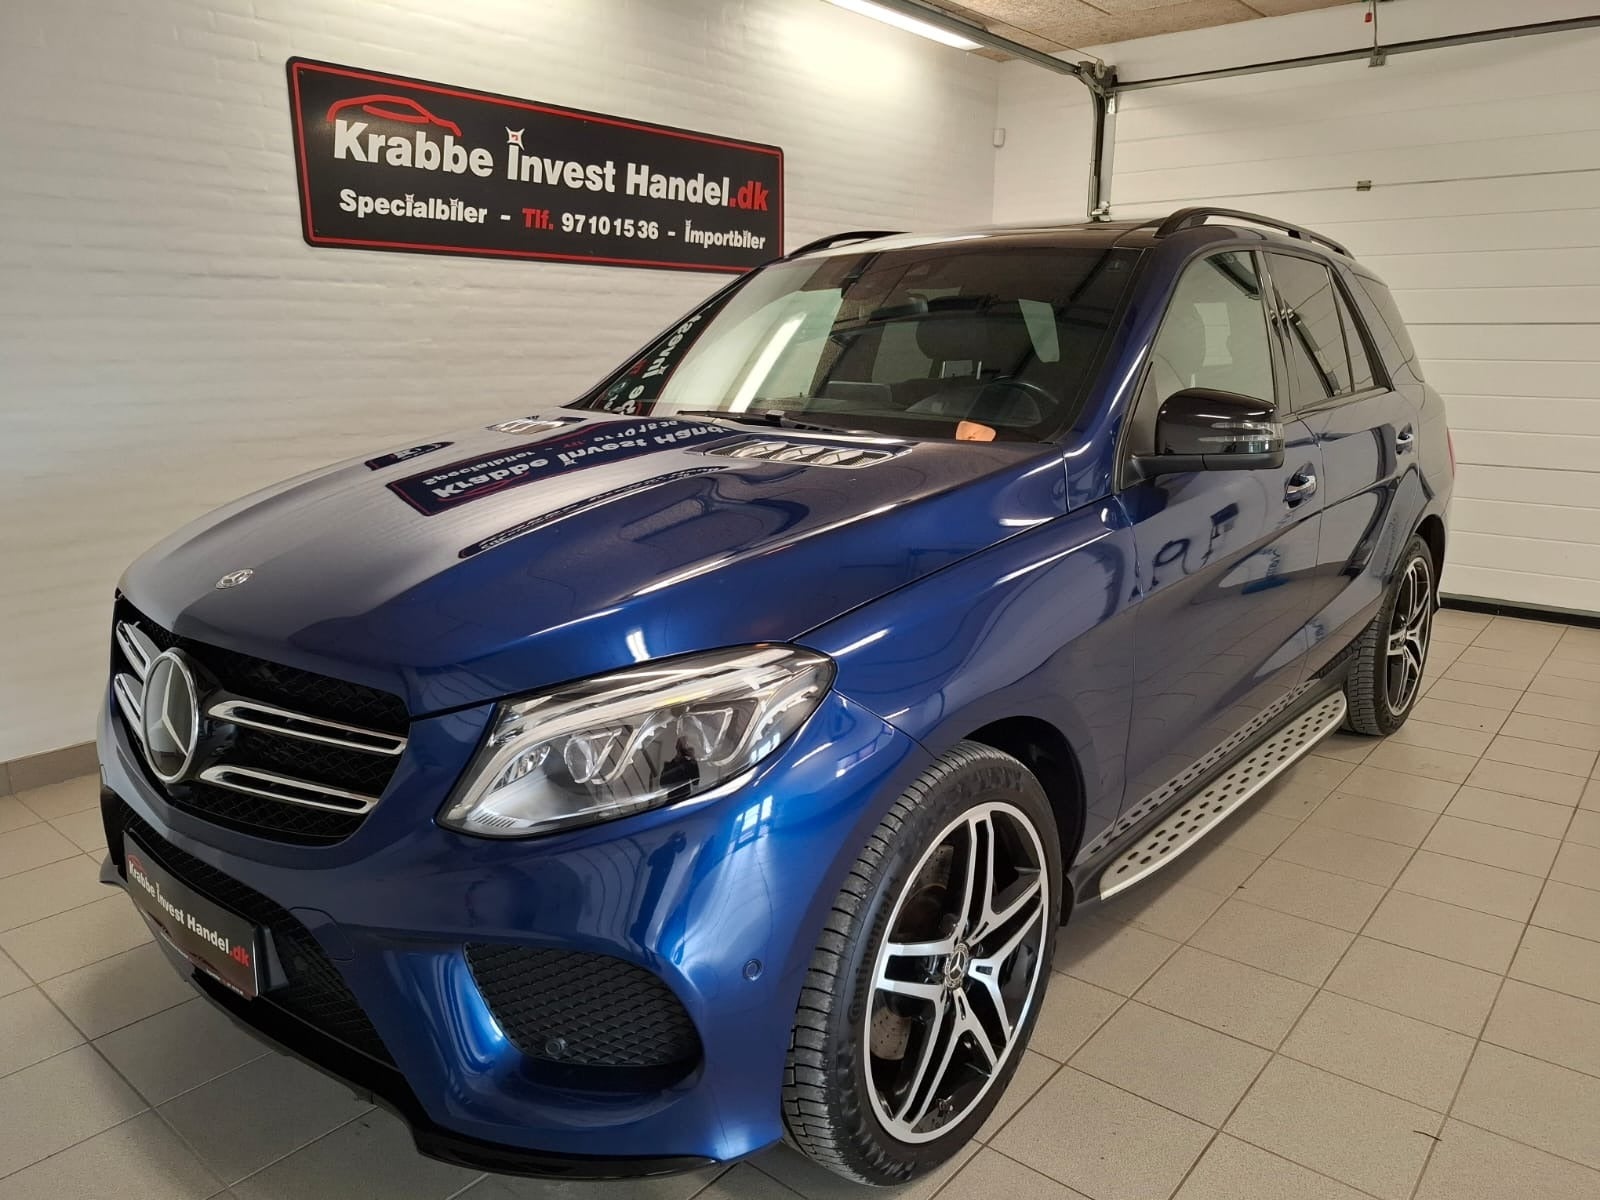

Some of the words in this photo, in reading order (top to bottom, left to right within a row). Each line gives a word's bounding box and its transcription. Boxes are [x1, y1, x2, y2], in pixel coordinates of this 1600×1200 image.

[333, 119, 494, 177] Krabbe
[507, 126, 616, 193] Invest
[626, 162, 769, 211] Handel.dk
[339, 188, 488, 224] Specialbiler
[522, 208, 554, 230] Tlf.
[684, 219, 766, 249] Importbiler
